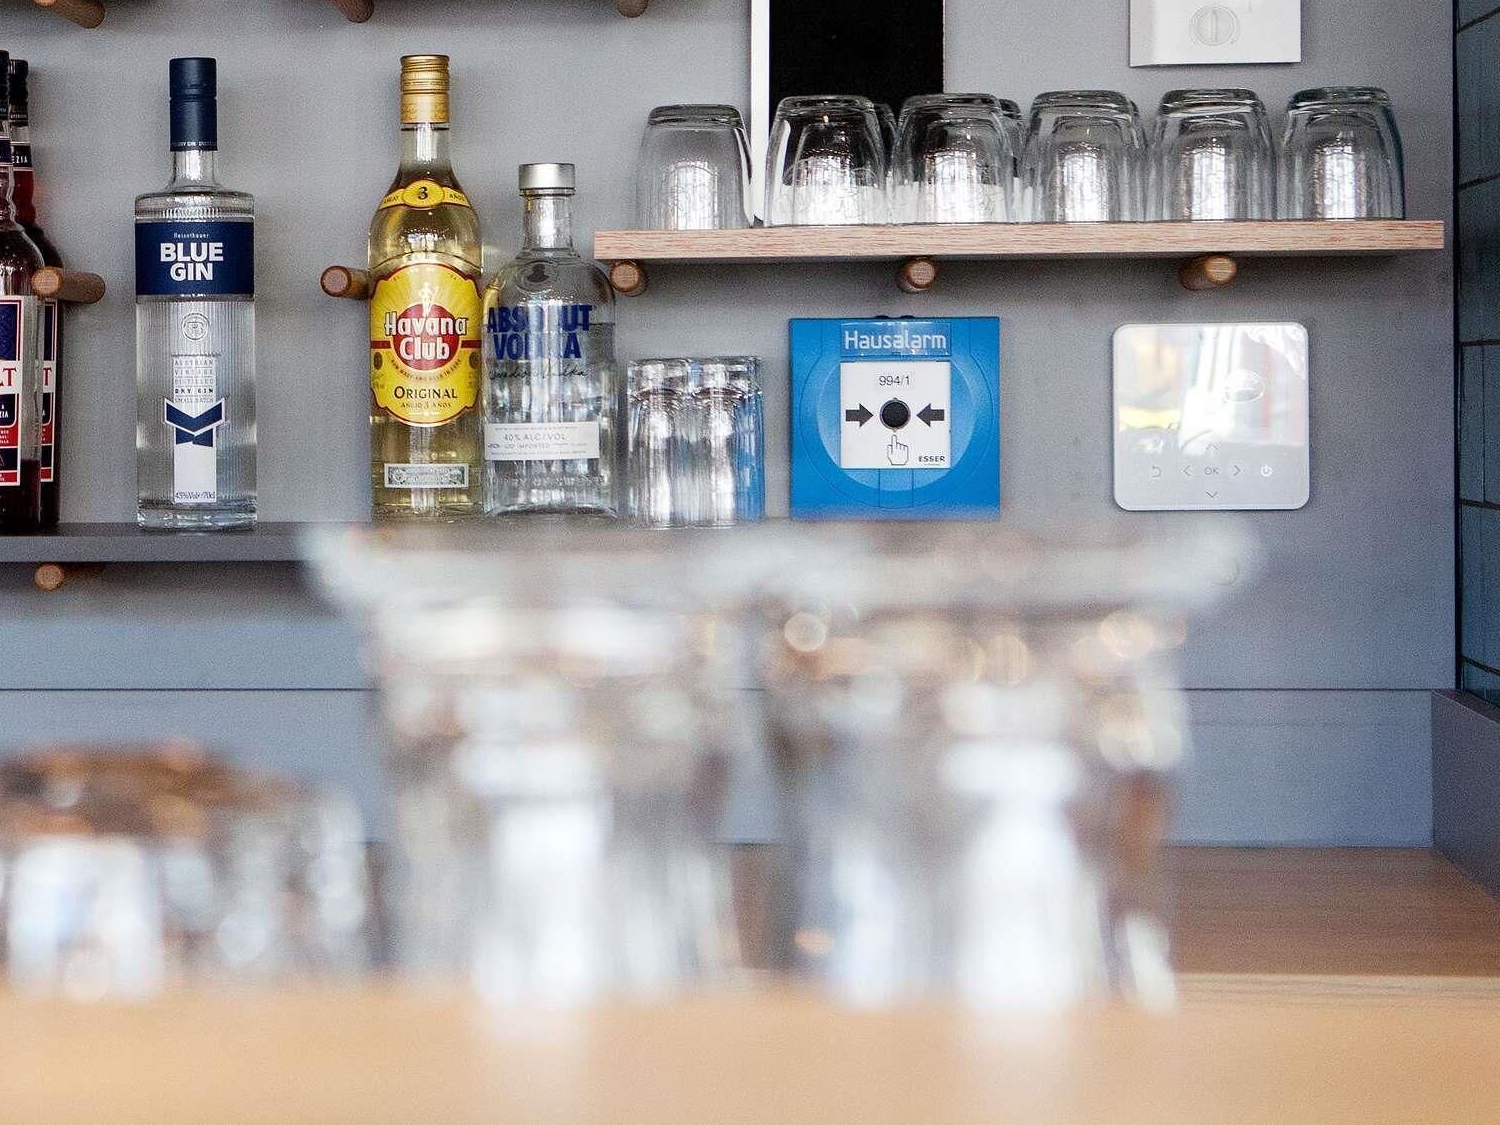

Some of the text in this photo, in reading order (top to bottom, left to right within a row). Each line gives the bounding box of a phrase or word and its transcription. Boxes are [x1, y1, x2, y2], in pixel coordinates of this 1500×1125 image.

[418, 186, 429, 200] 3
[160, 242, 224, 262] BLUE
[170, 262, 213, 281] GIN
[385, 311, 468, 336] Havana
[486, 304, 593, 333] ABSOUT
[400, 336, 450, 360] Club
[844, 329, 947, 350] Hausalarm
[878, 376, 911, 386] 994/1
[394, 386, 458, 399] ORIGINAL
[423, 401, 430, 409] 3
[1204, 467, 1220, 475] OK
